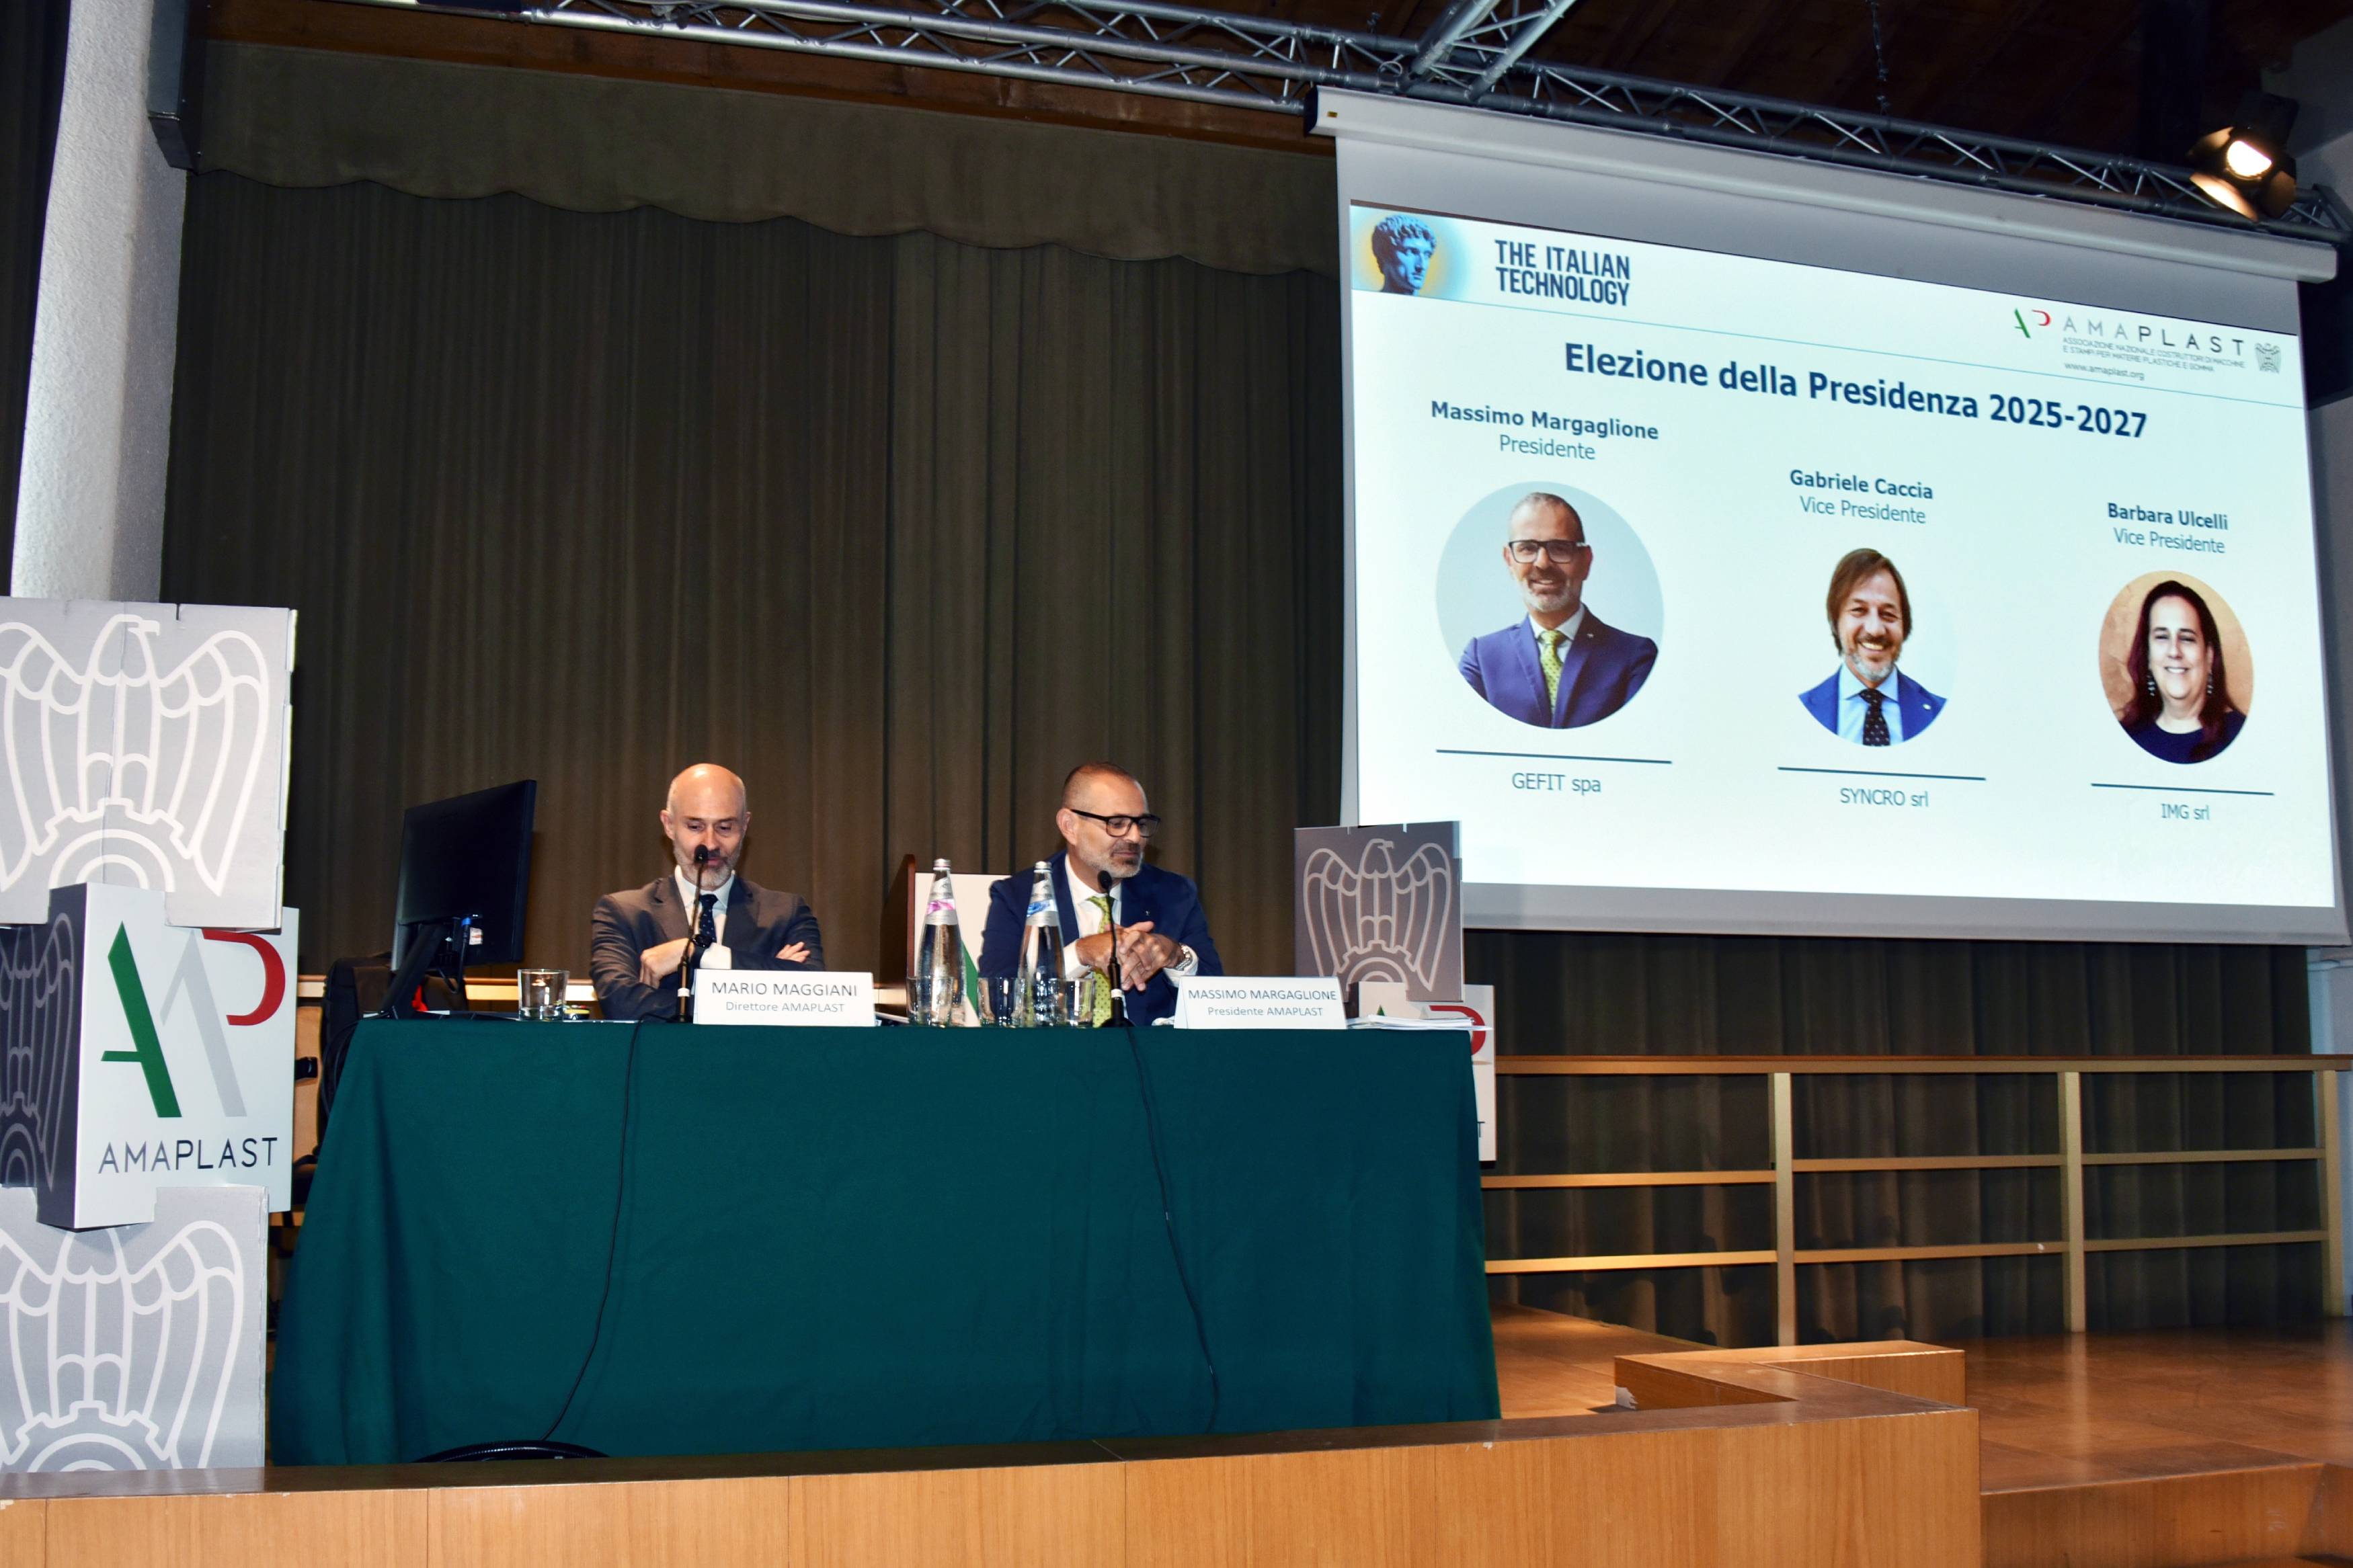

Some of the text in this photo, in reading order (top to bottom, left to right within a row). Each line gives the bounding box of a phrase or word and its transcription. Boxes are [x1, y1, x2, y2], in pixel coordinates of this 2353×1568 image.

[1494, 239, 1630, 280] THE ITALIAN
[1495, 266, 1630, 306] TECHNOLOGY
[2063, 316, 2245, 356] AMAPLAST
[2063, 345, 2068, 353] E
[2116, 344, 2155, 356] NAZIONALE
[2065, 362, 2145, 381] www.amaplast.org
[1565, 342, 2147, 438] Elezione della Presidenza 2025-2027
[1431, 401, 1659, 440] Massimo Margaglione
[1499, 435, 1596, 460] Presidente
[1790, 469, 1933, 499] Gabriele Caccia
[1800, 495, 1927, 524] Vice Presidente
[2107, 502, 2229, 530] Barbara Ulcelli
[2114, 527, 2226, 554] Vice Presidente
[1512, 772, 1601, 796] GEFIT spa
[1839, 788, 1929, 807] SYNCRO srl
[2161, 803, 2210, 821] IMG srl
[711, 981, 858, 997] MARIO MAGGIANI
[1188, 989, 1337, 1001] MASSIMO MARGAGLIONE
[725, 1000, 845, 1013] Direttore AMAPLAST
[1207, 1006, 1323, 1018] Presidente AMAPLAST
[99, 1137, 278, 1174] AMAPLAST
